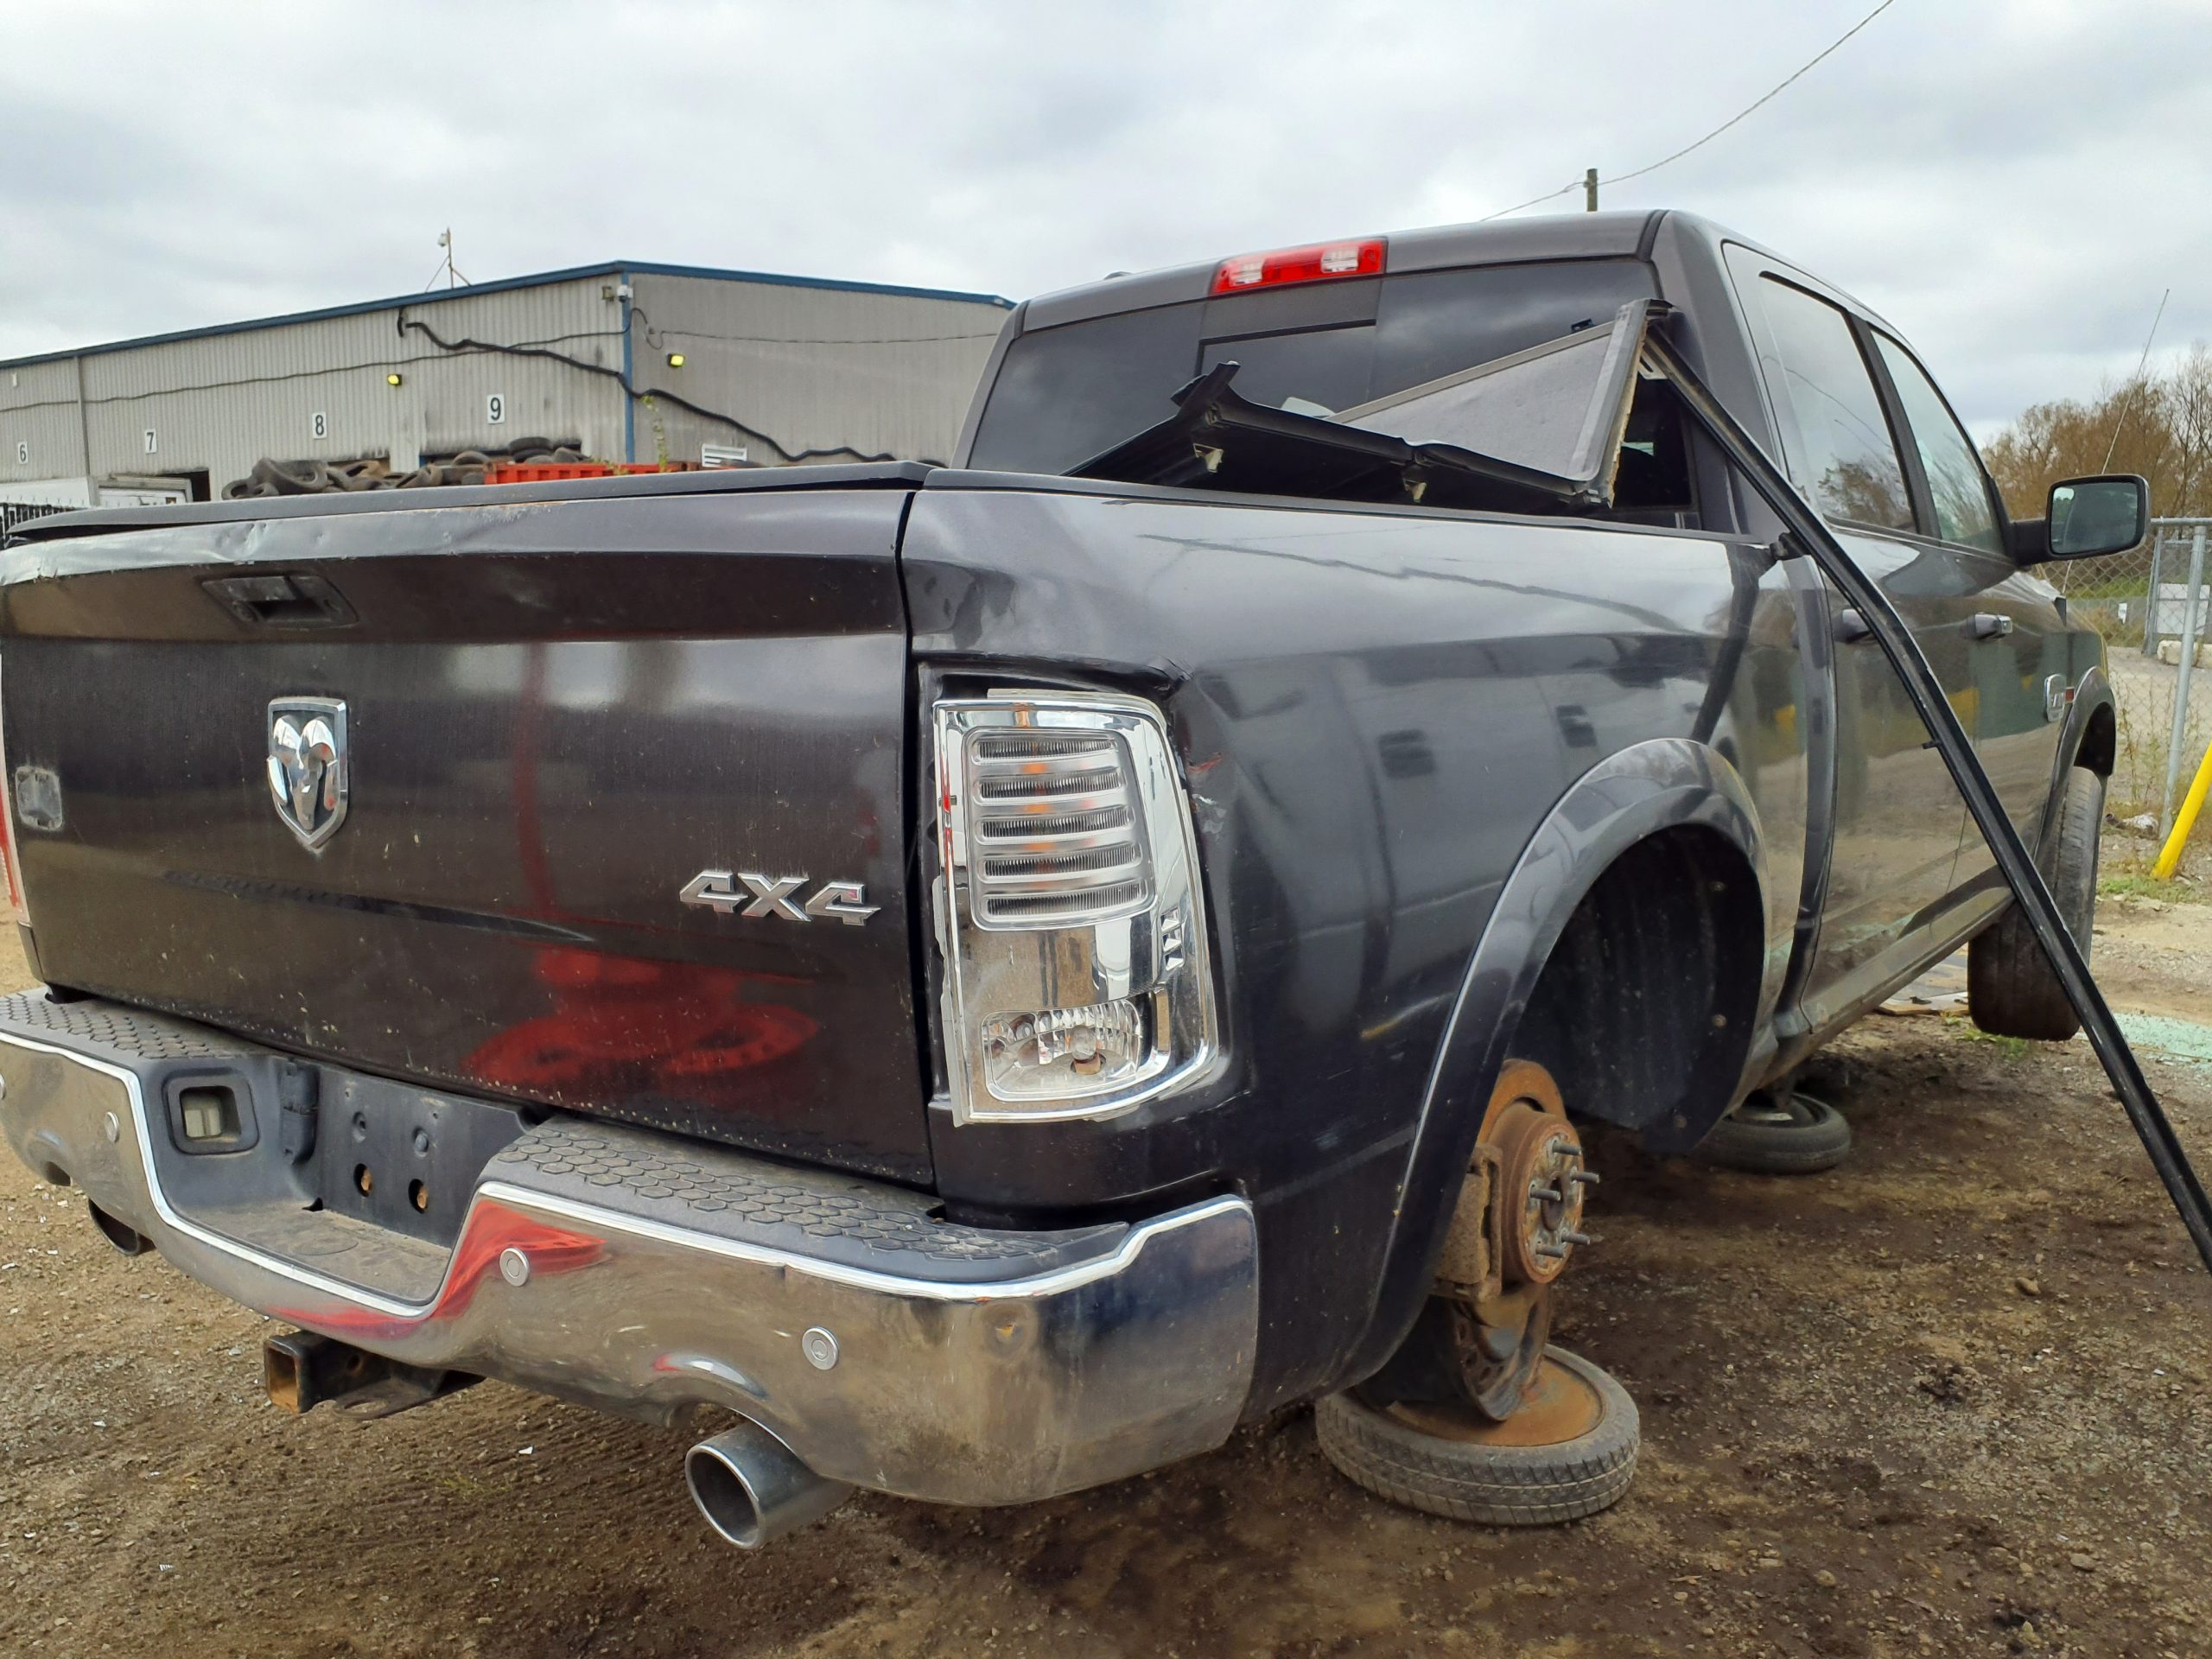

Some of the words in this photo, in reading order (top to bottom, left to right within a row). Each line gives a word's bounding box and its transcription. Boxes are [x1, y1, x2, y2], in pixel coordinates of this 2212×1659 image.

[490, 397, 501, 421] 9
[315, 414, 325, 435] 8
[146, 432, 155, 451] 7
[19, 444, 27, 462] 6
[679, 869, 881, 926] 4X4
